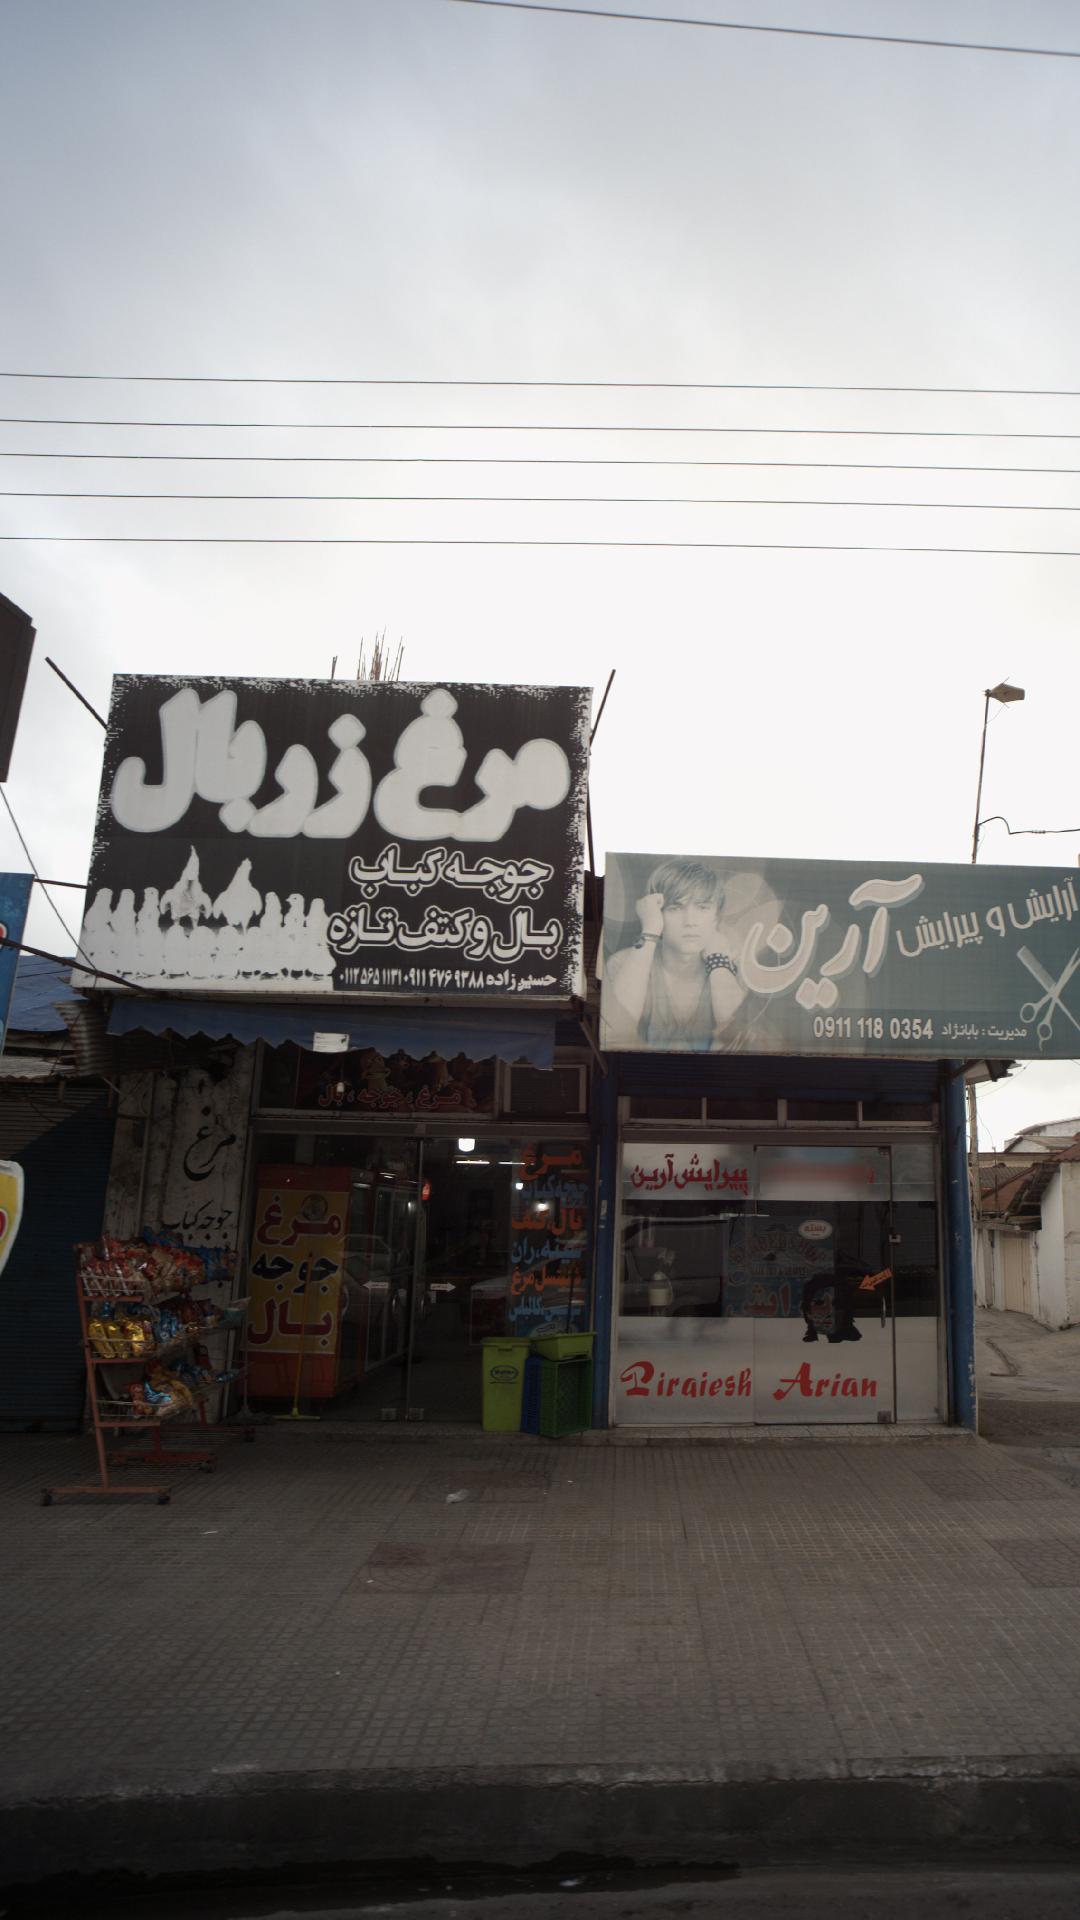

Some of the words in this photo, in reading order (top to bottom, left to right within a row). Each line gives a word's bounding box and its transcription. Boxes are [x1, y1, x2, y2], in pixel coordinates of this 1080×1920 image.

[111, 688, 372, 838] زربال
[374, 688, 570, 842] مرغ
[349, 843, 447, 899] کباب
[441, 850, 554, 904] جوجه
[986, 906, 1006, 937] و
[1007, 876, 1078, 929] آرایش
[327, 902, 398, 955] تازه
[396, 905, 475, 952] کتف
[464, 915, 493, 960] و
[490, 906, 563, 964] بال
[740, 874, 925, 1010] آرین
[896, 912, 984, 957] پیرایش
[813, 1016, 850, 1038] 0911
[857, 1017, 883, 1039] 118
[890, 1017, 934, 1040] 0354
[183, 1106, 237, 1181] مرغ
[631, 1154, 675, 1190] آرین
[674, 1154, 749, 1196] پیرایش
[201, 1208, 233, 1240] جوجه
[255, 1195, 341, 1245] مرغ
[251, 1253, 338, 1296] جوجه
[247, 1298, 332, 1346] بال
[620, 1361, 751, 1398] Piraiesh
[773, 1362, 878, 1400] Arian
